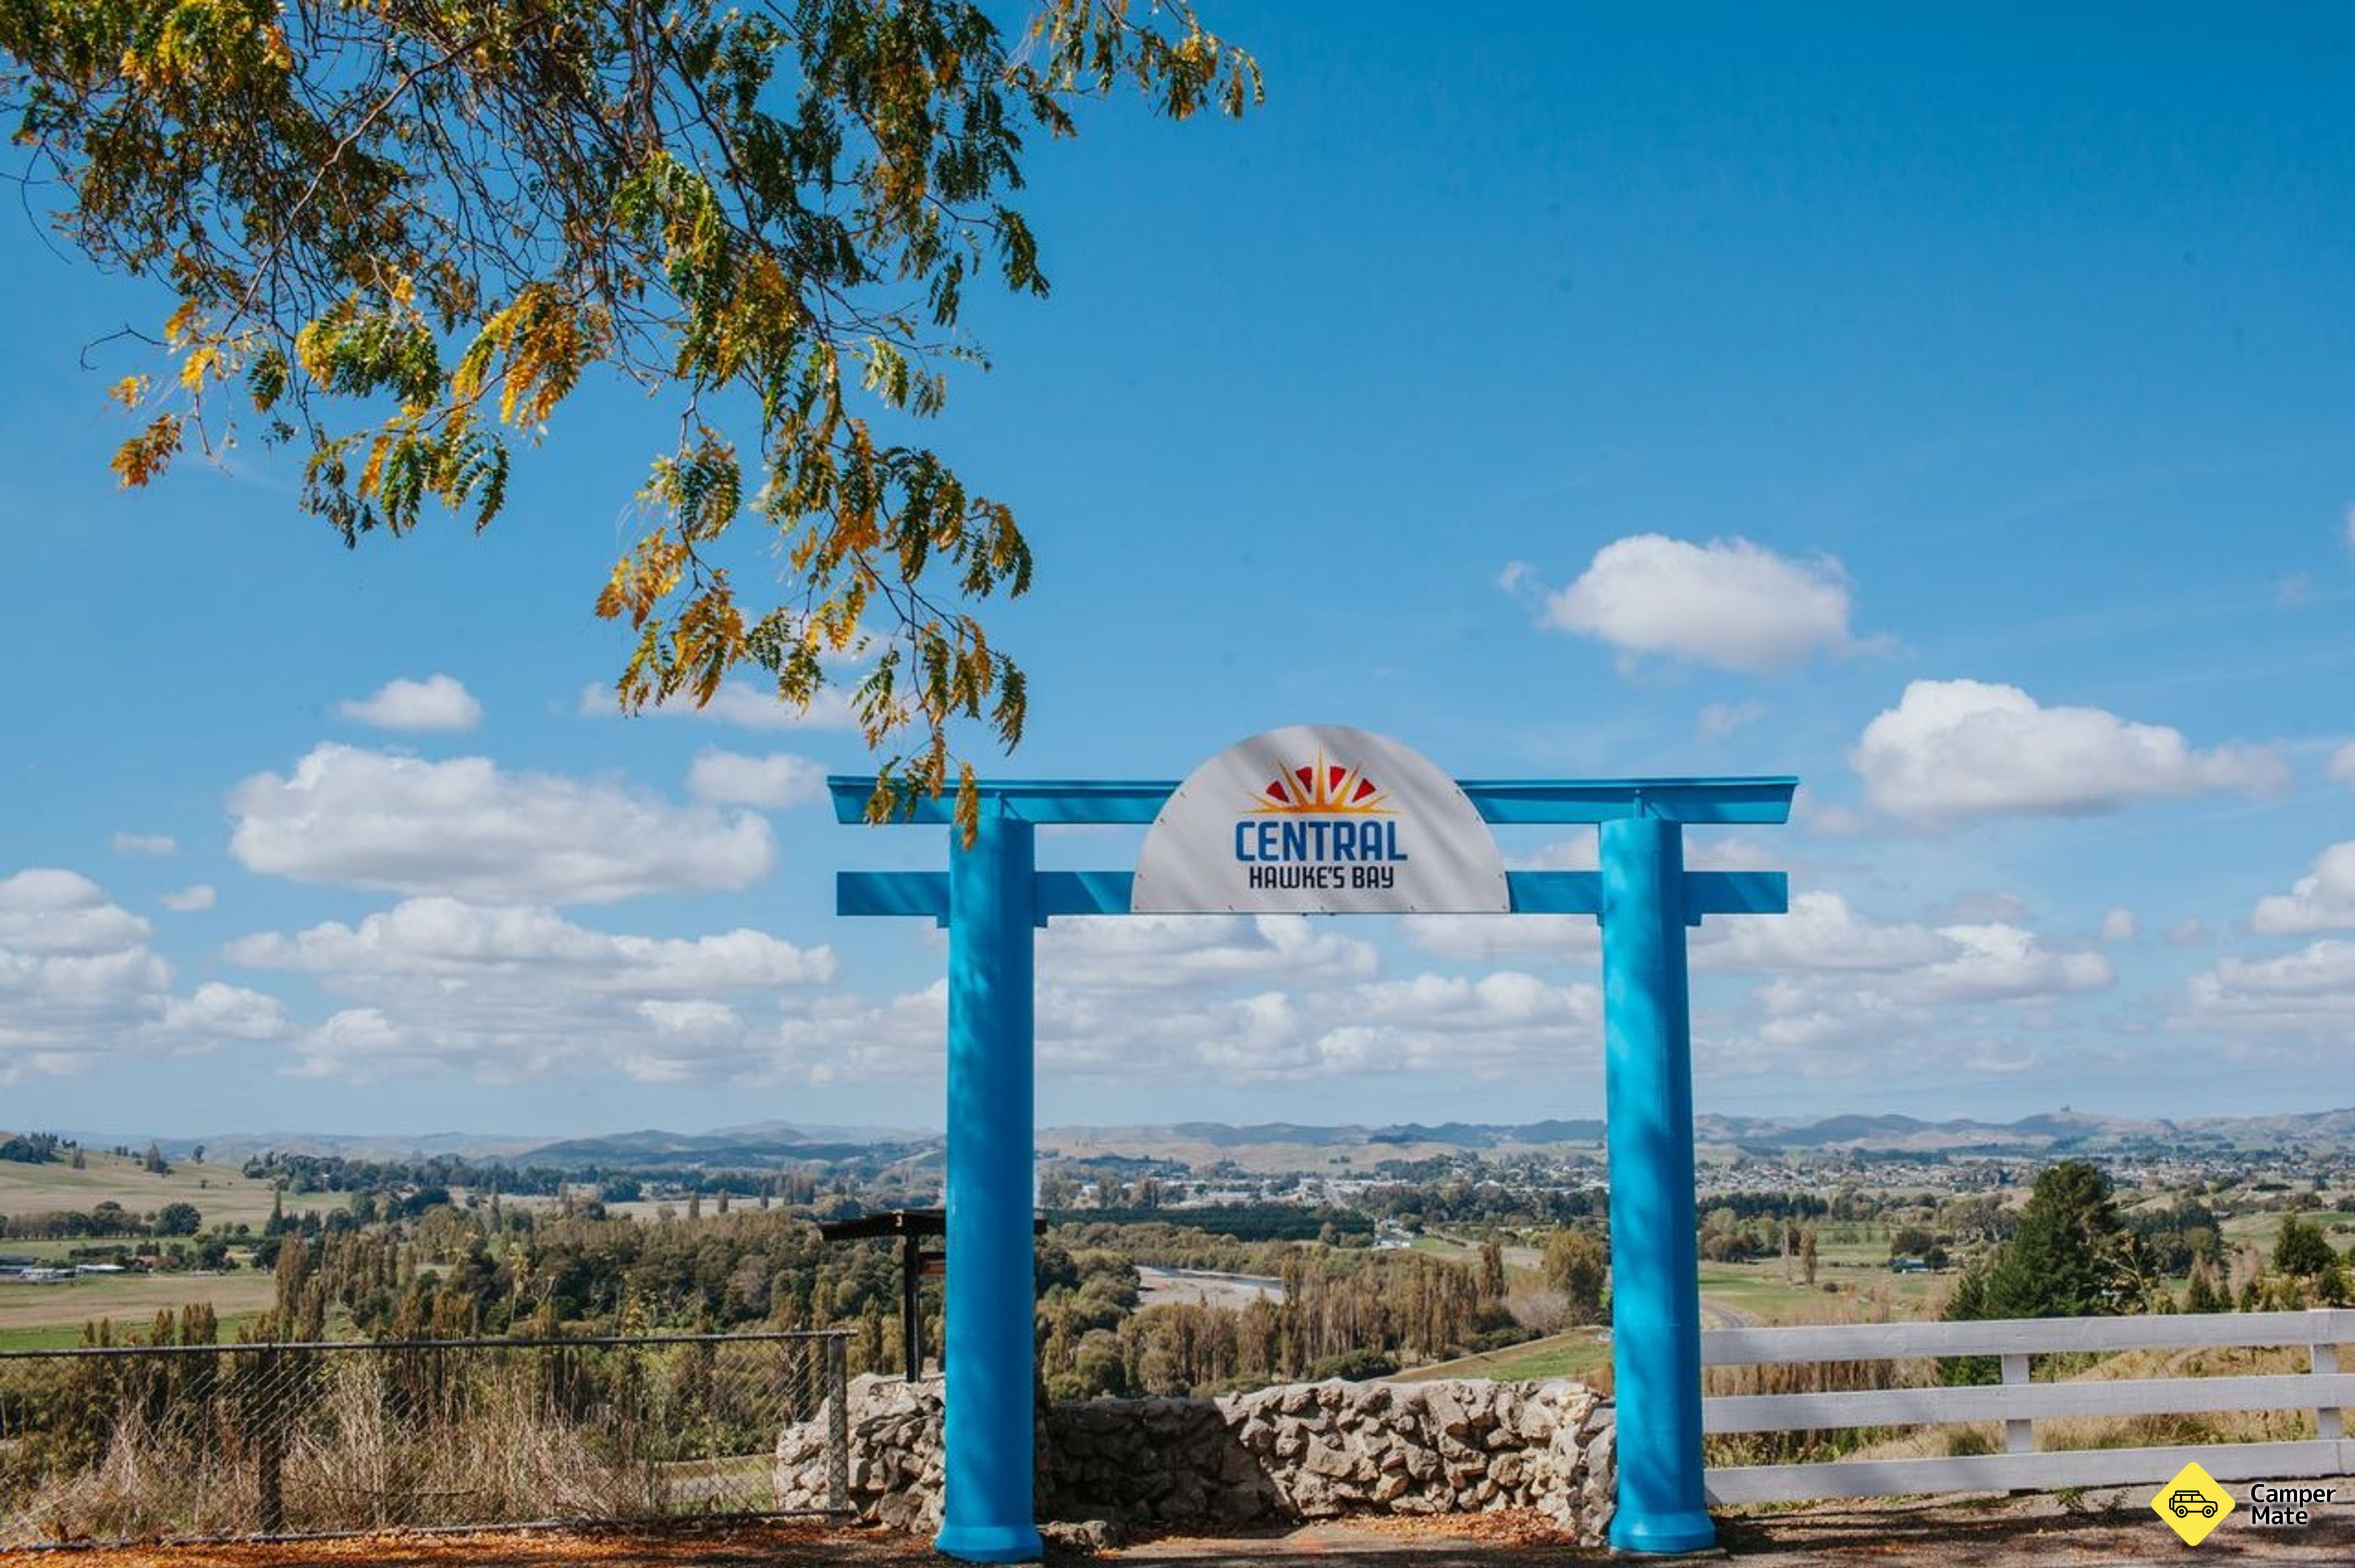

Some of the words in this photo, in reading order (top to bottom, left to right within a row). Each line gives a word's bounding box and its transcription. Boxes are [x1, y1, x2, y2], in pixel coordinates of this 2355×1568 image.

[1235, 821, 1408, 861] CENTRAL
[1249, 866, 1345, 889] HAWKE'S
[1352, 866, 1394, 889] BAY
